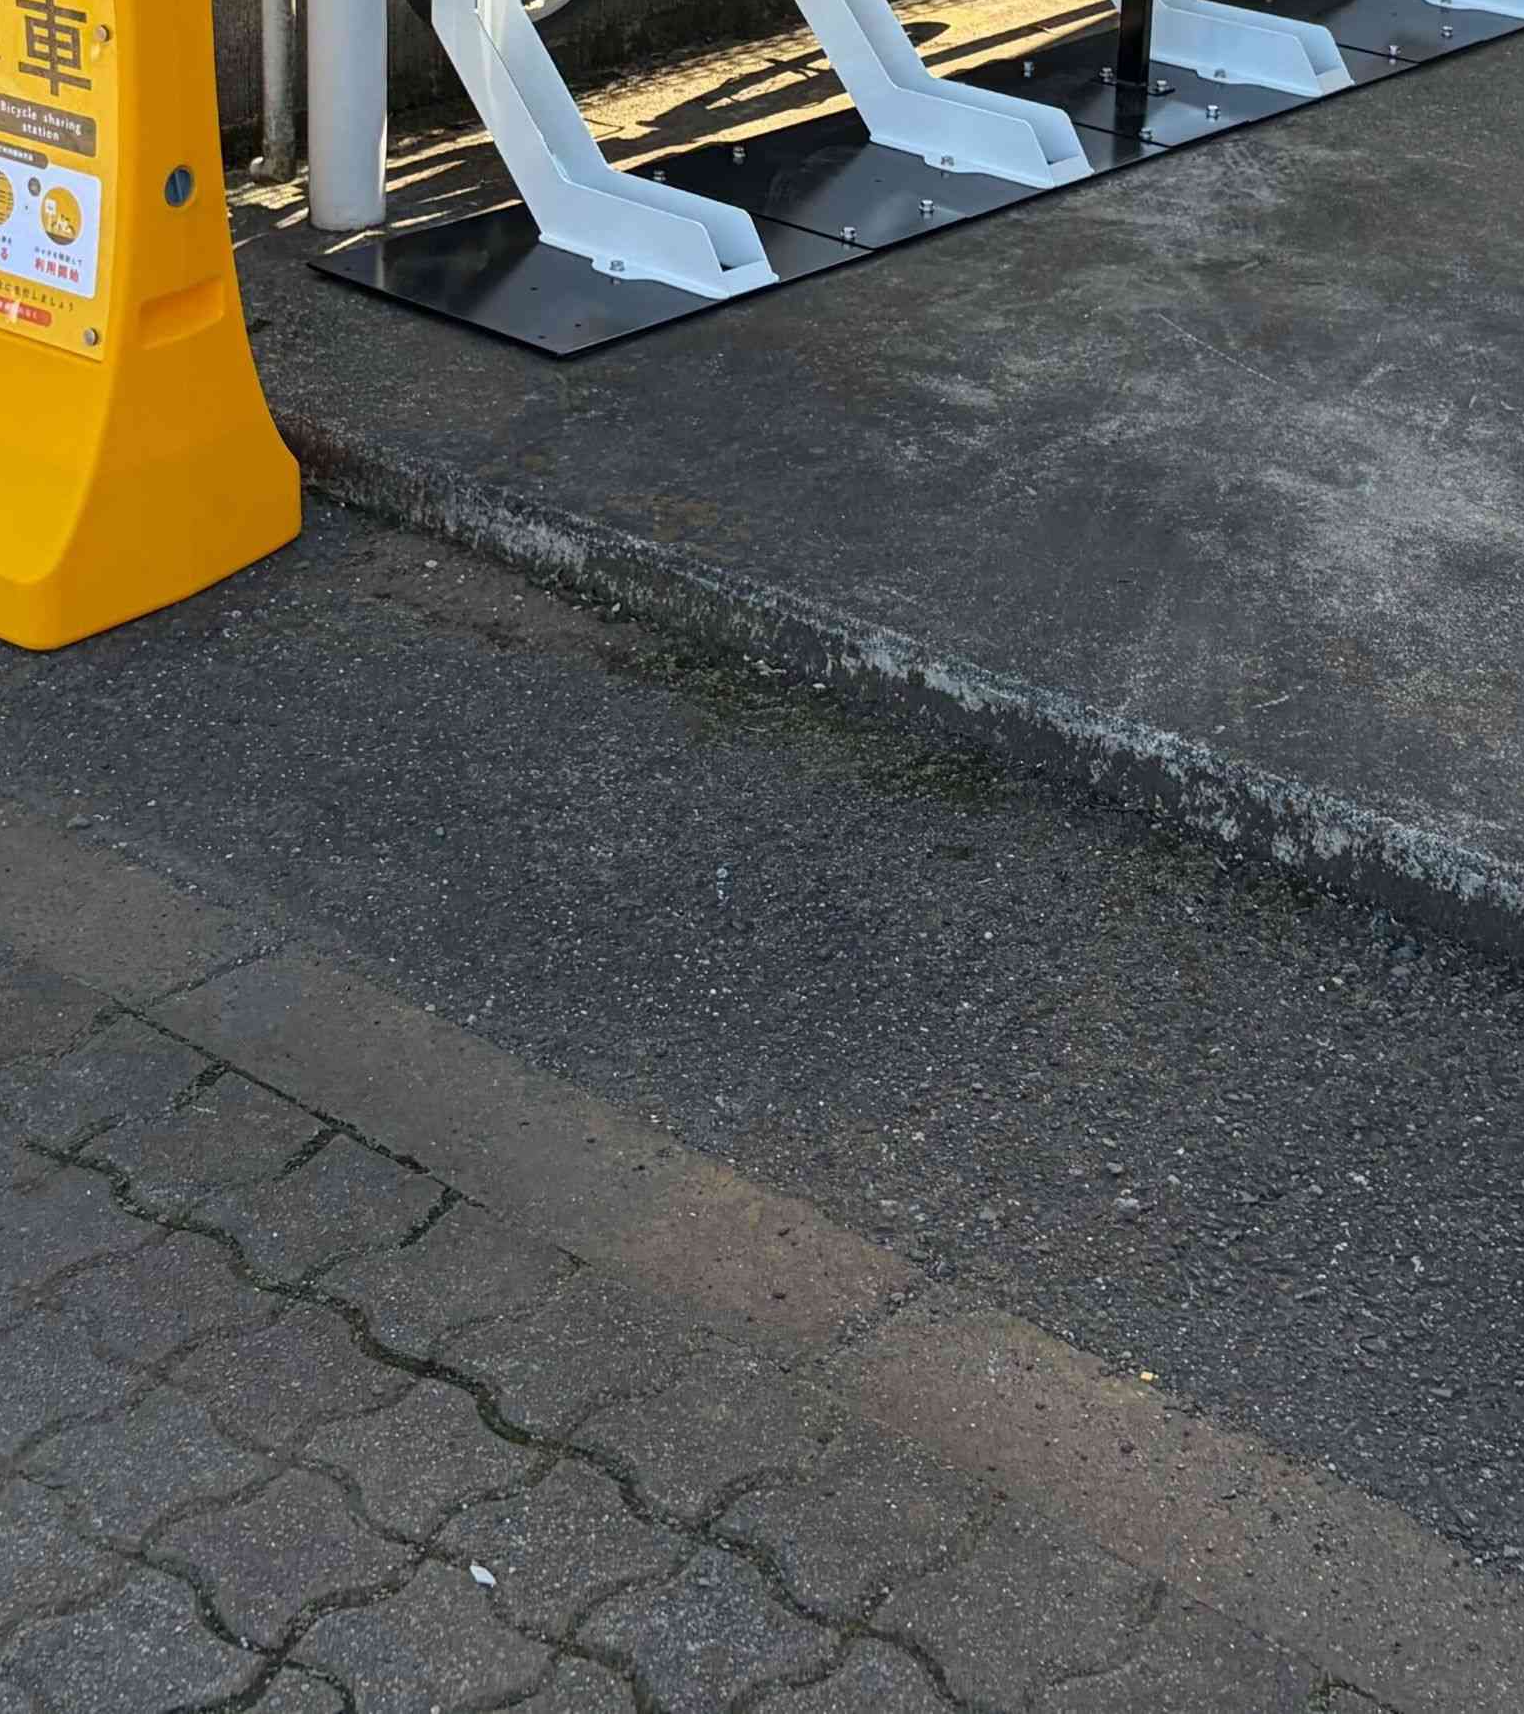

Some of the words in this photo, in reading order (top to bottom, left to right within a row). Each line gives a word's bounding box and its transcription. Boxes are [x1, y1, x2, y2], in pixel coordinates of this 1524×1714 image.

[0, 99, 38, 122] Bicycle
[43, 112, 83, 137] sharing
[22, 122, 60, 141] station
[34, 257, 80, 283] 利用開始
